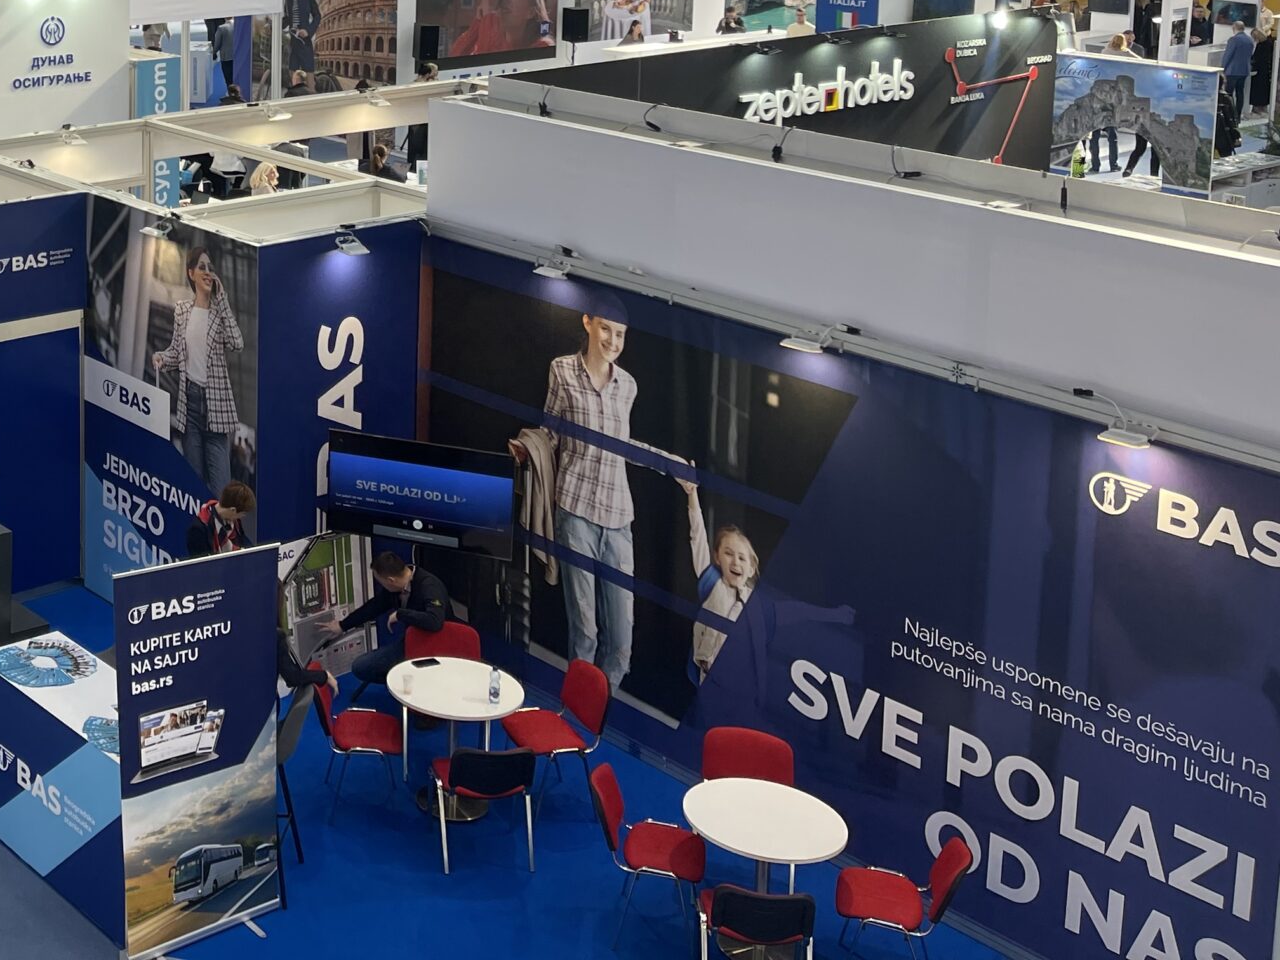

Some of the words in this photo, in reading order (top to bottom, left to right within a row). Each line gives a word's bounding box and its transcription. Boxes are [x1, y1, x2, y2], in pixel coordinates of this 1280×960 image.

[31, 54, 74, 71] ДУНАВ
[1026, 54, 1053, 65] BEOGRAD
[12, 71, 92, 90] ОСИГУРАЊЕ
[12, 251, 48, 272] BAS
[119, 385, 152, 416] BAS
[103, 452, 201, 517] JEDNOSTAVN
[356, 479, 378, 492] SVE
[380, 483, 422, 498] POLAZI
[423, 490, 442, 502] OD
[103, 478, 165, 536] BRZO
[1156, 487, 1280, 569] BAS
[151, 595, 196, 620] BAS
[130, 632, 181, 656] KUPITE
[184, 620, 231, 644] KARTU
[131, 659, 152, 676] NA
[153, 647, 199, 670] SAJTU
[131, 675, 173, 696] bas.rs
[904, 616, 987, 666] Najlepše
[991, 654, 1101, 713] uspomene
[1106, 698, 1132, 724] se
[1136, 710, 1236, 768] dešavaju
[1241, 753, 1271, 781] na
[891, 640, 1006, 701] putovanjima
[1011, 687, 1035, 711] sa
[1038, 701, 1097, 739] nama
[1101, 722, 1177, 773] dragim
[1182, 755, 1268, 808] ljudima
[16, 758, 62, 816] BAS
[787, 658, 924, 770] SVE
[945, 725, 1256, 922] POLAZI
[924, 810, 1041, 905] OD
